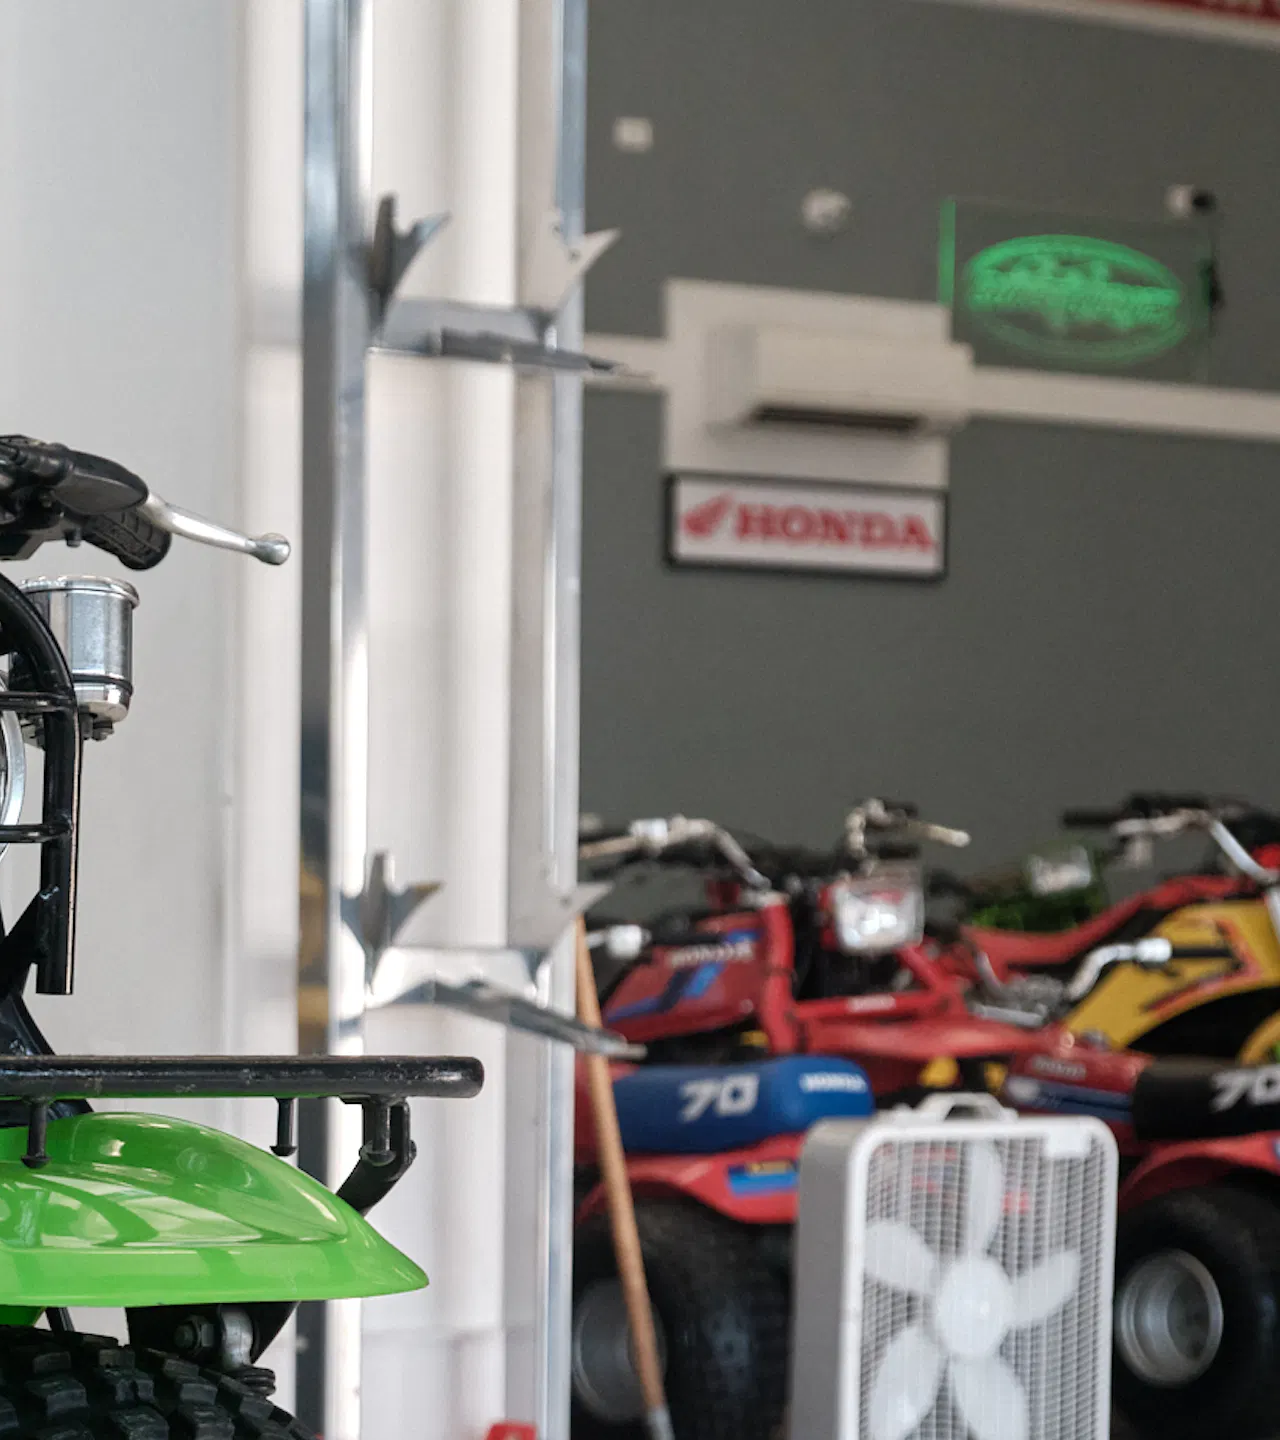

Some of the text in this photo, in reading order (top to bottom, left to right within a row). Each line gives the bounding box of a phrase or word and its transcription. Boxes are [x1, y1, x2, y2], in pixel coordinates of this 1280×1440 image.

[736, 501, 934, 553] HONDA
[678, 1073, 761, 1121] 70
[1208, 1066, 1280, 1113] 70
